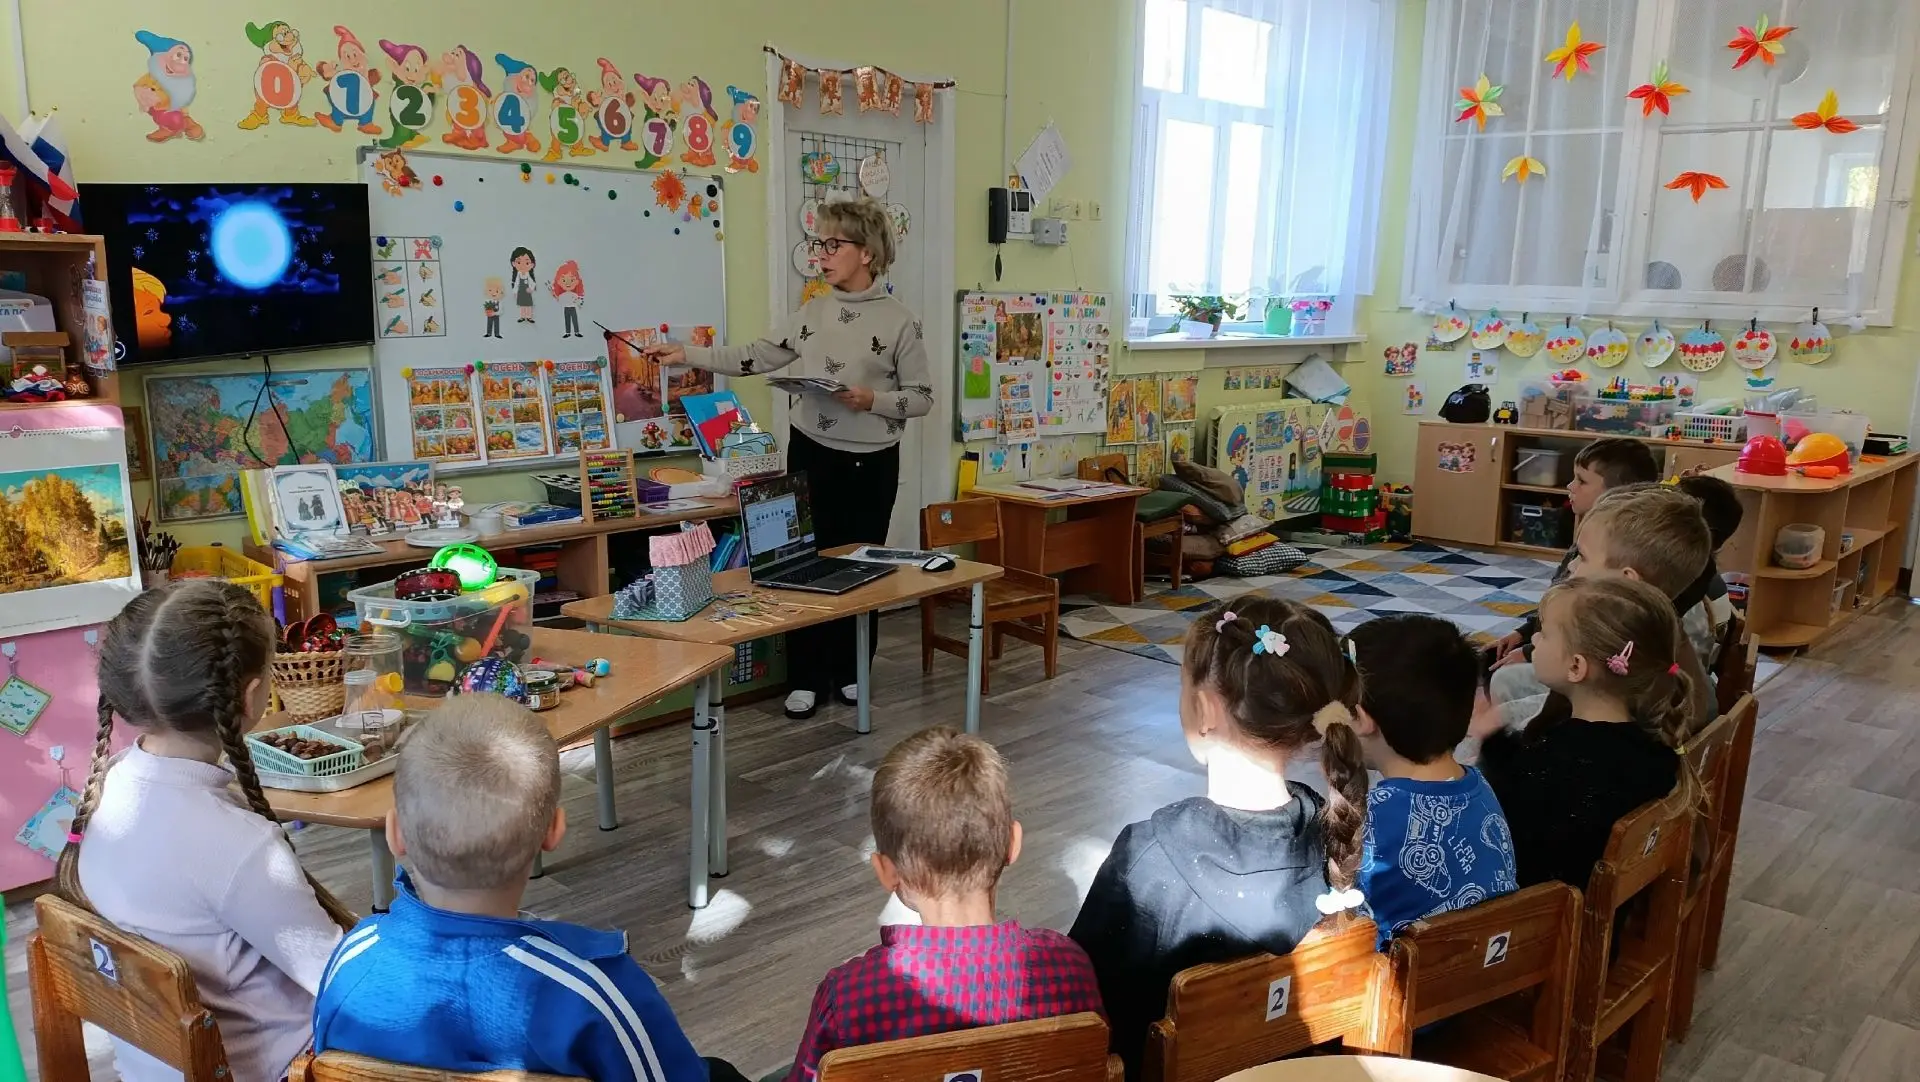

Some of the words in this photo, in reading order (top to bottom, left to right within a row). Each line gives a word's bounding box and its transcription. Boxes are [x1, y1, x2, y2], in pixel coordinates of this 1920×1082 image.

[262, 71, 294, 107] 0
[337, 73, 362, 115] 1
[396, 85, 426, 127] 2
[455, 87, 481, 127] 3
[498, 93, 526, 133] 4
[557, 106, 579, 145] 5
[604, 97, 627, 136] 6
[648, 121, 668, 155] 7
[687, 115, 709, 152] 8
[732, 124, 753, 158] 9
[1052, 293, 1079, 305] НАШИ
[1081, 294, 1106, 306] ДЕЛА
[1063, 307, 1076, 317] НА
[1077, 307, 1101, 318] ДЕНЬ
[492, 363, 525, 372] ОСЕНЬ
[560, 363, 589, 371] ОСЕНЬ
[1487, 936, 1509, 964] 2
[94, 943, 115, 978] 2
[1271, 987, 1285, 1012] 2
